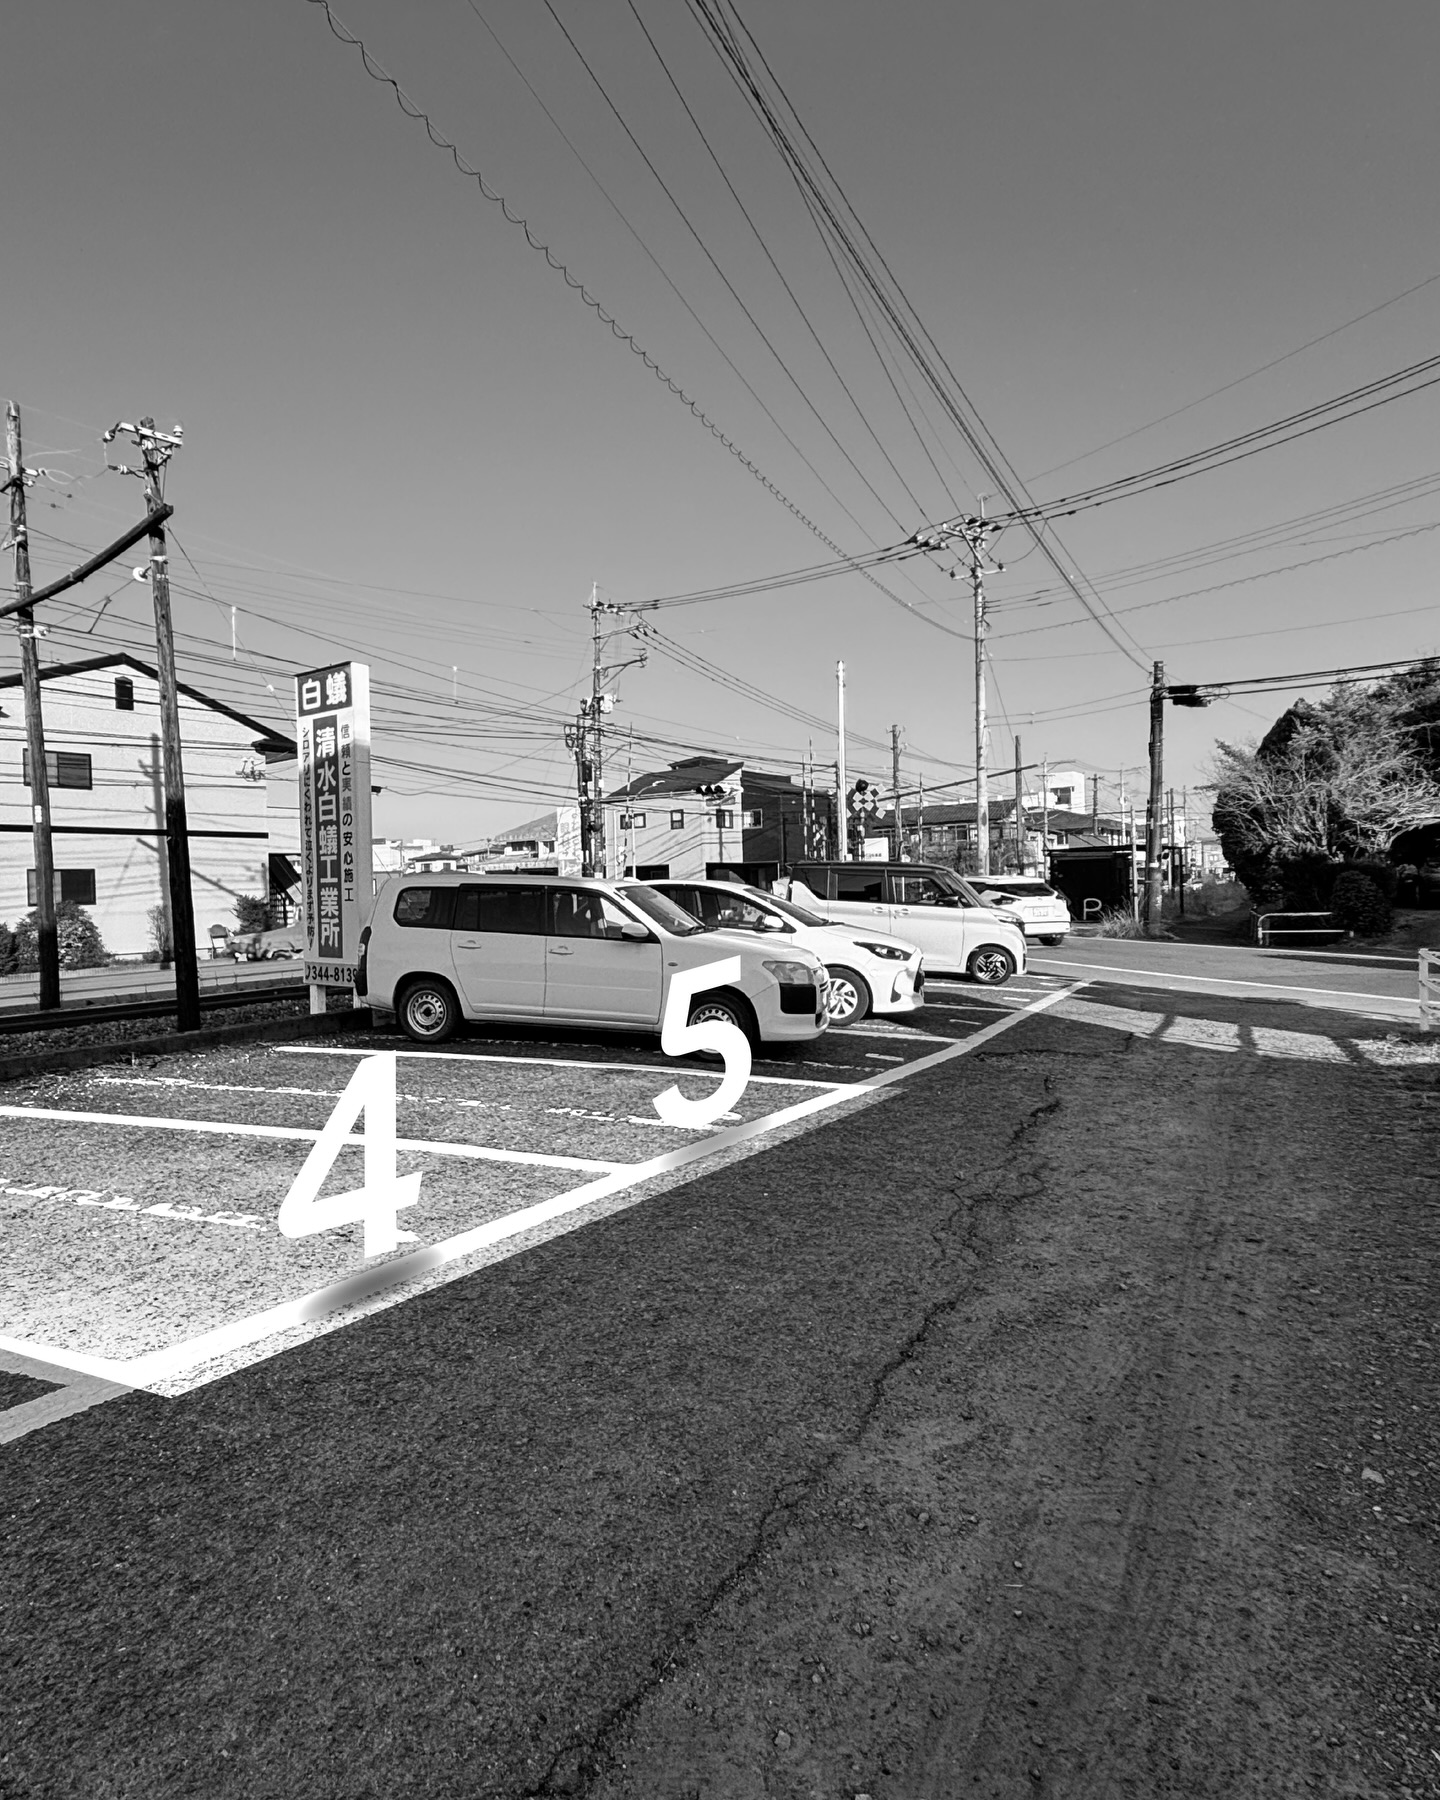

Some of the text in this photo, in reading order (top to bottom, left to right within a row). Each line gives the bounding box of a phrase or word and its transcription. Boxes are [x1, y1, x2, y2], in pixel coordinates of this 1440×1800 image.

[302, 670, 347, 710] 白蟻
[316, 726, 340, 947] 清水白蟻工業所
[340, 723, 354, 902] 信頼と実績の安心施工
